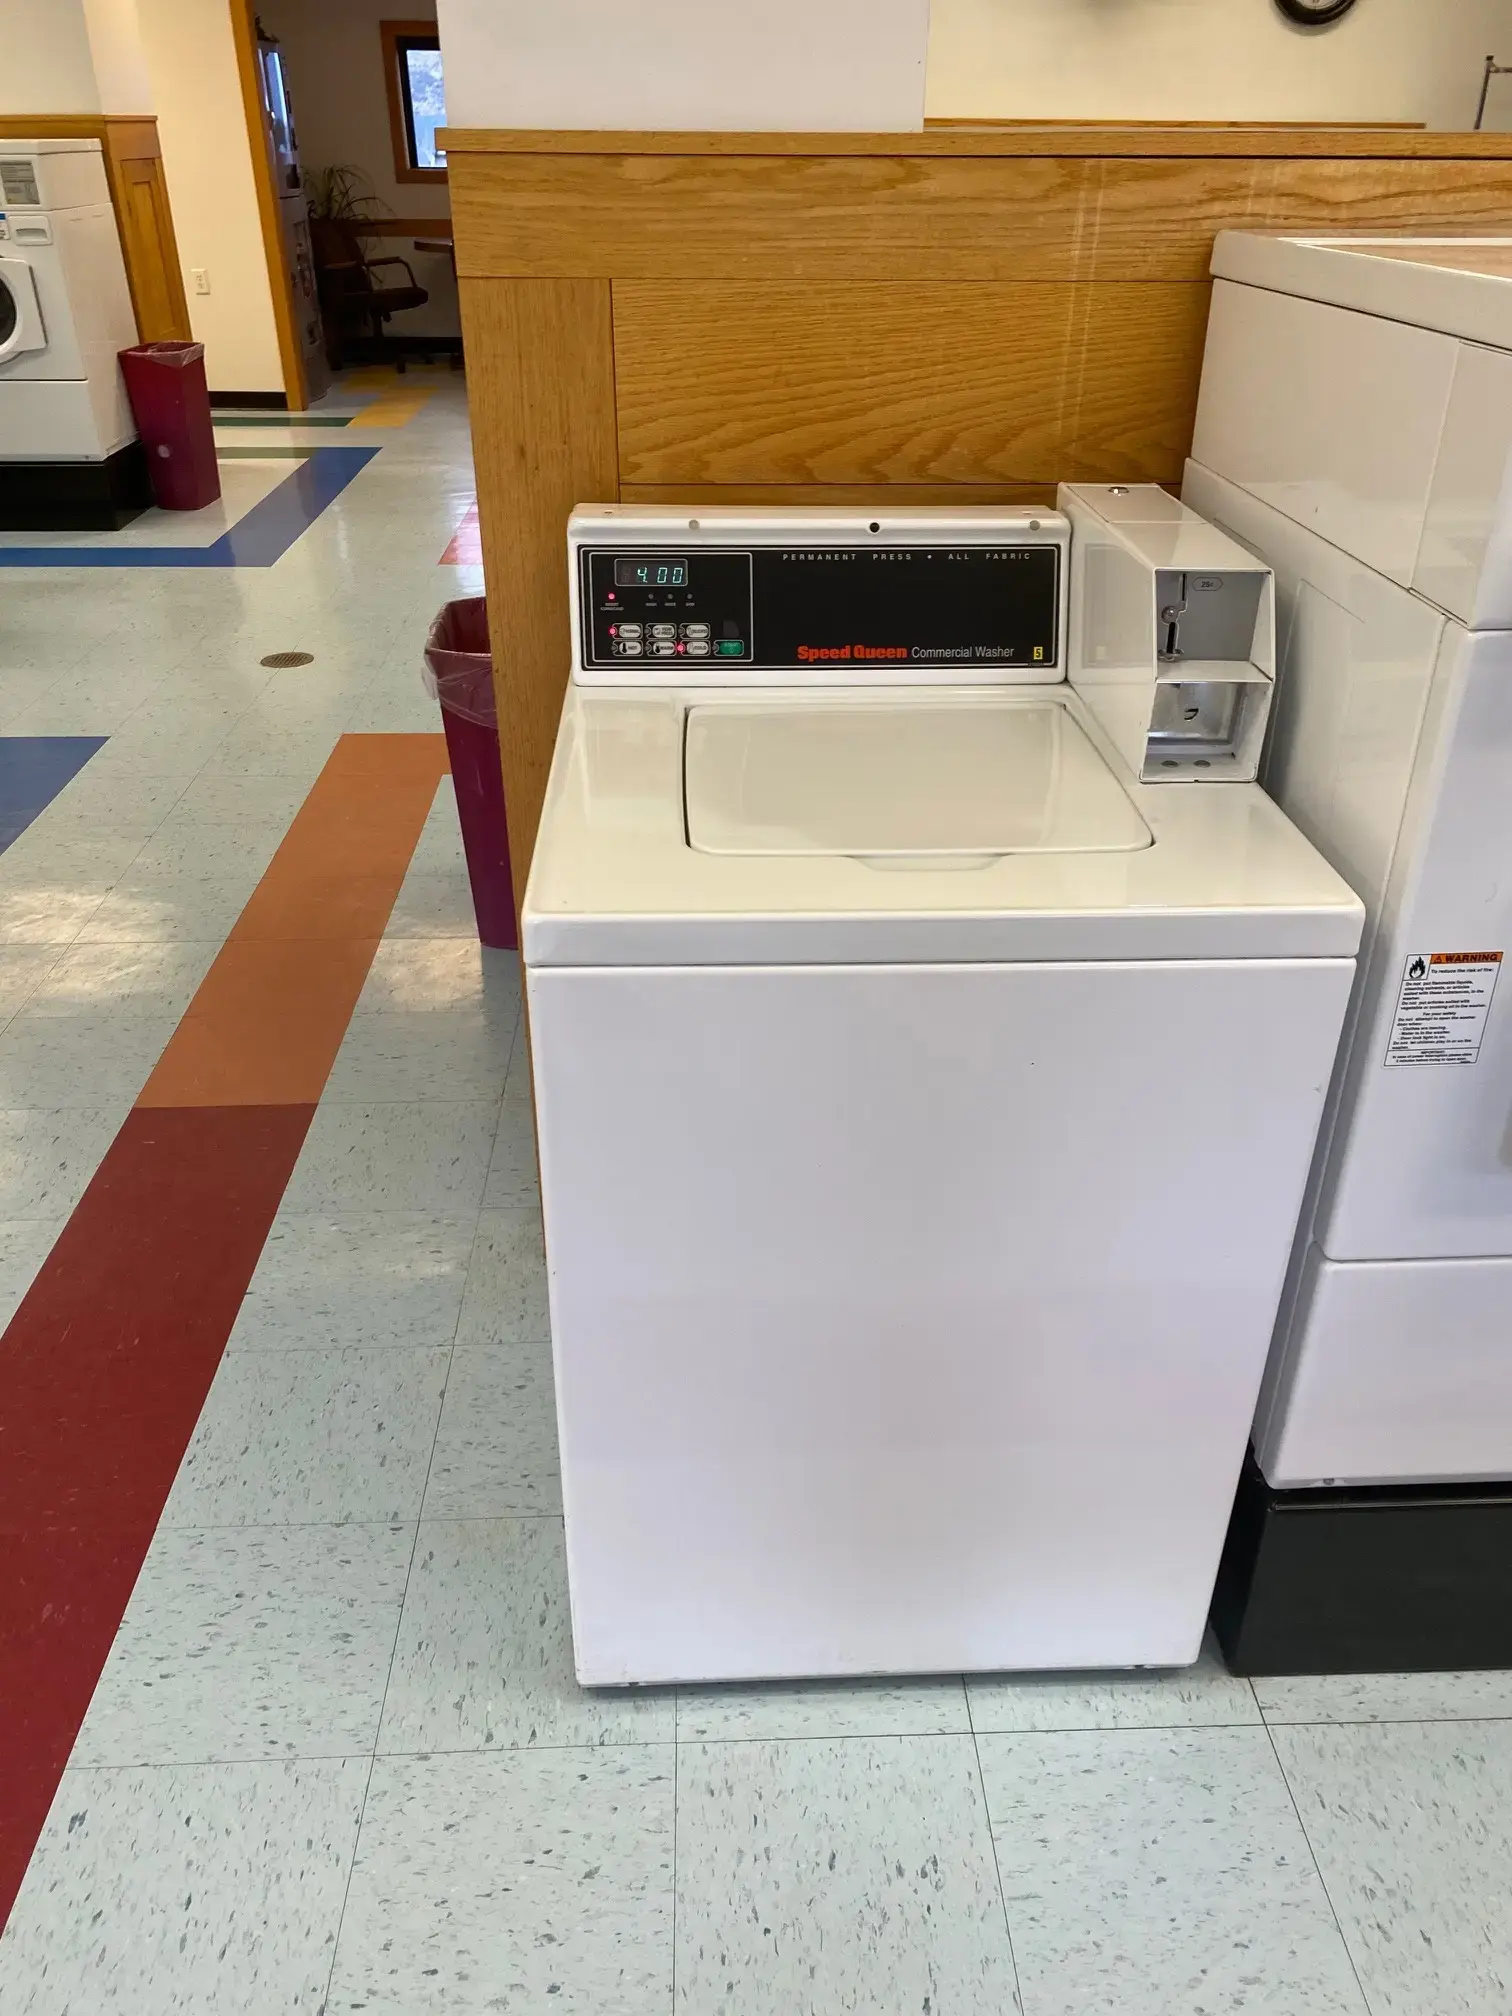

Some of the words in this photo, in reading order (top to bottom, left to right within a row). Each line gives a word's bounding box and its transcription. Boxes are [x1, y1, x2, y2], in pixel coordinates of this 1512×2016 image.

[797, 645, 850, 662] Speed
[853, 646, 907, 659] Queen
[911, 646, 972, 658] Commercial
[975, 647, 1014, 658] Washer
[1446, 954, 1497, 963] WARNING
